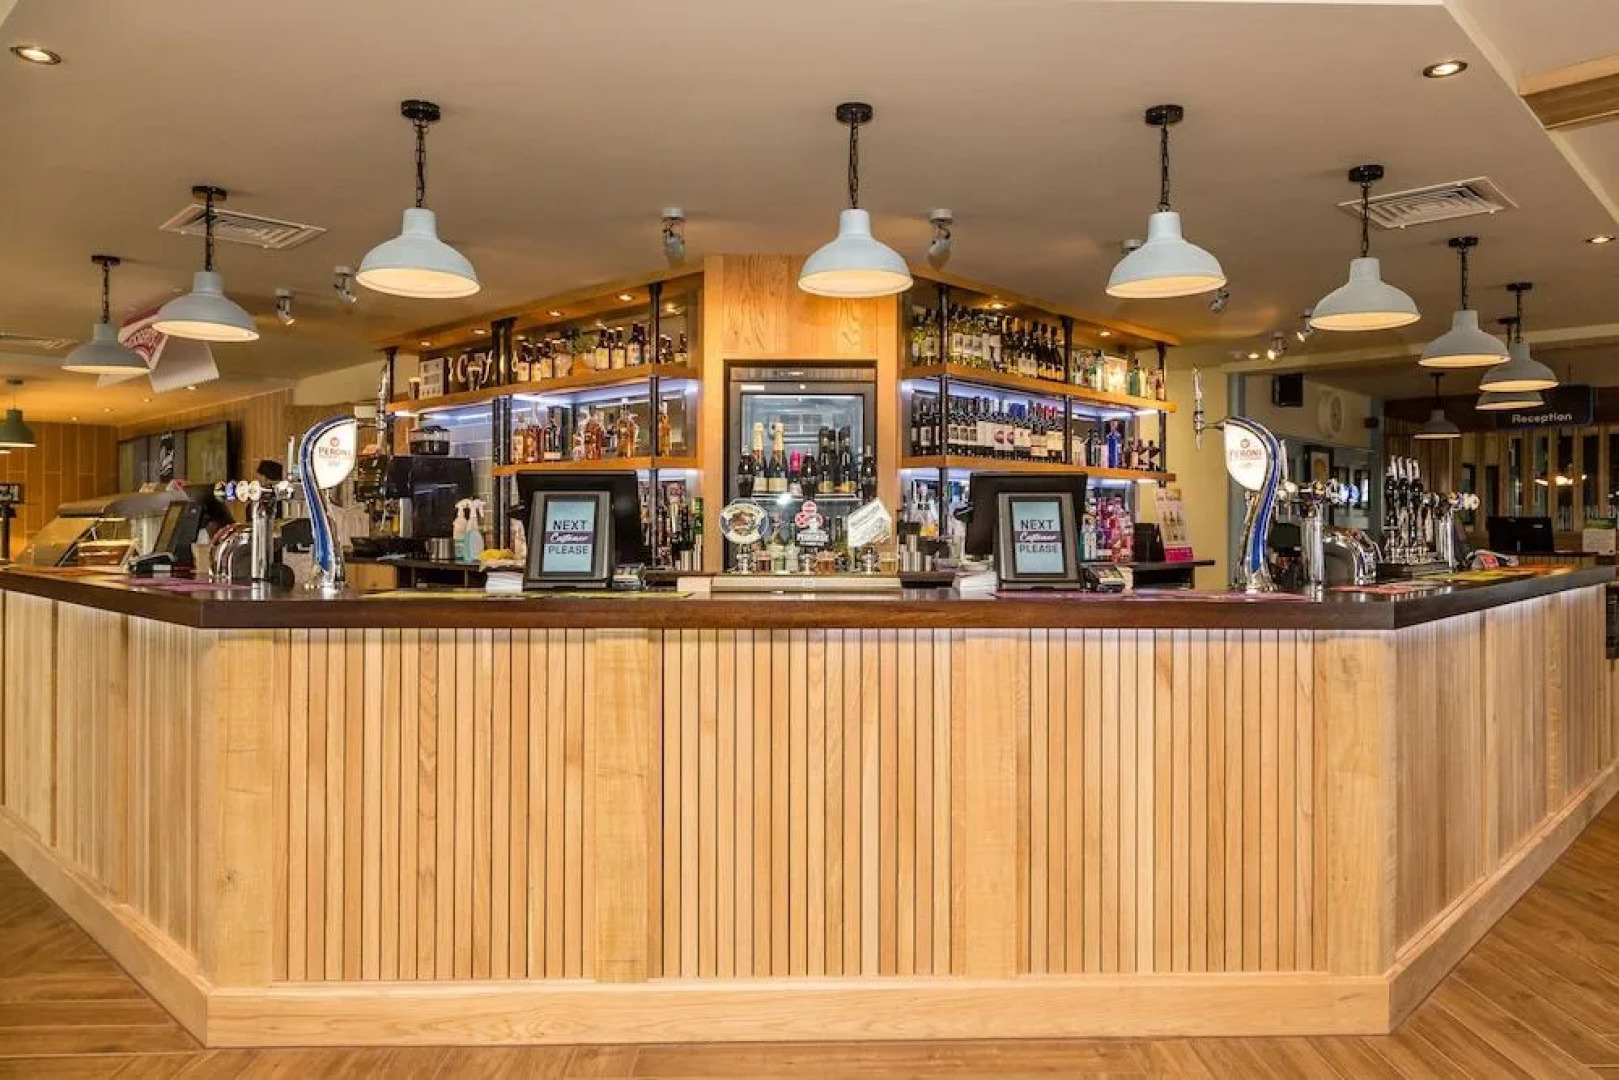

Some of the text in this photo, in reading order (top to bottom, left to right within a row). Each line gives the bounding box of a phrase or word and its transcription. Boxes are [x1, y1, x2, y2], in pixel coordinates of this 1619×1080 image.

[1511, 412, 1573, 424] Reception
[318, 446, 352, 456] PERONI
[553, 519, 589, 530] NEXT
[1020, 519, 1055, 530] NEXT
[548, 545, 589, 555] PLEASE
[1019, 544, 1059, 554] PLEASE
